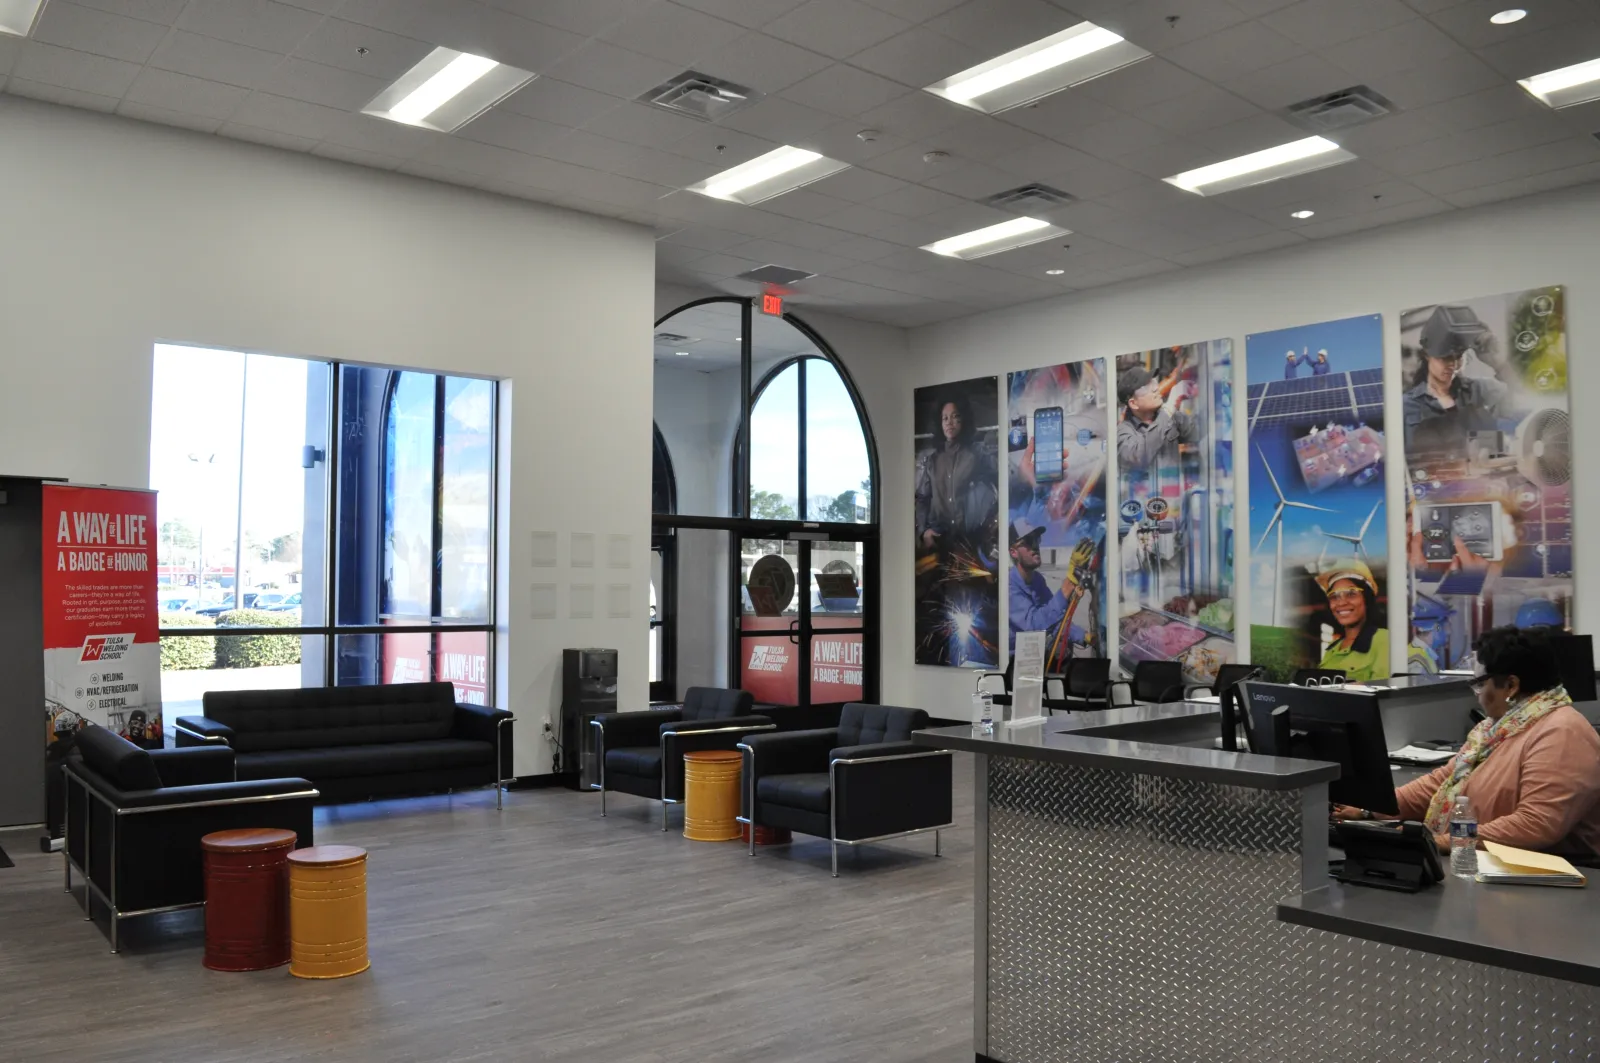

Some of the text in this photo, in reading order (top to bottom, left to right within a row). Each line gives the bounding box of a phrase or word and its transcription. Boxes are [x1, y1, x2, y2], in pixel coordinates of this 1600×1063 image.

[764, 295, 781, 315] EXIT
[57, 511, 70, 543] A
[73, 511, 110, 544] WAY
[116, 514, 146, 545] LIFE
[57, 551, 66, 571] A
[70, 552, 105, 572] BADGE
[114, 552, 148, 572] HONOR
[103, 644, 128, 652] WELDING
[768, 646, 784, 654] TULSA
[814, 641, 820, 662] A
[821, 641, 841, 663] WAY
[766, 654, 788, 663] WELDING
[449, 654, 466, 680] WAY
[469, 654, 485, 684] LIFE
[763, 663, 782, 672] SCHOOL
[102, 673, 124, 682] WELDING
[814, 668, 819, 682] A
[820, 669, 839, 684] BADGE
[87, 684, 138, 696] HVAC/REFRIGERATION
[99, 697, 127, 708] ELECTRICAL
[1252, 692, 1276, 702] Lenovo
